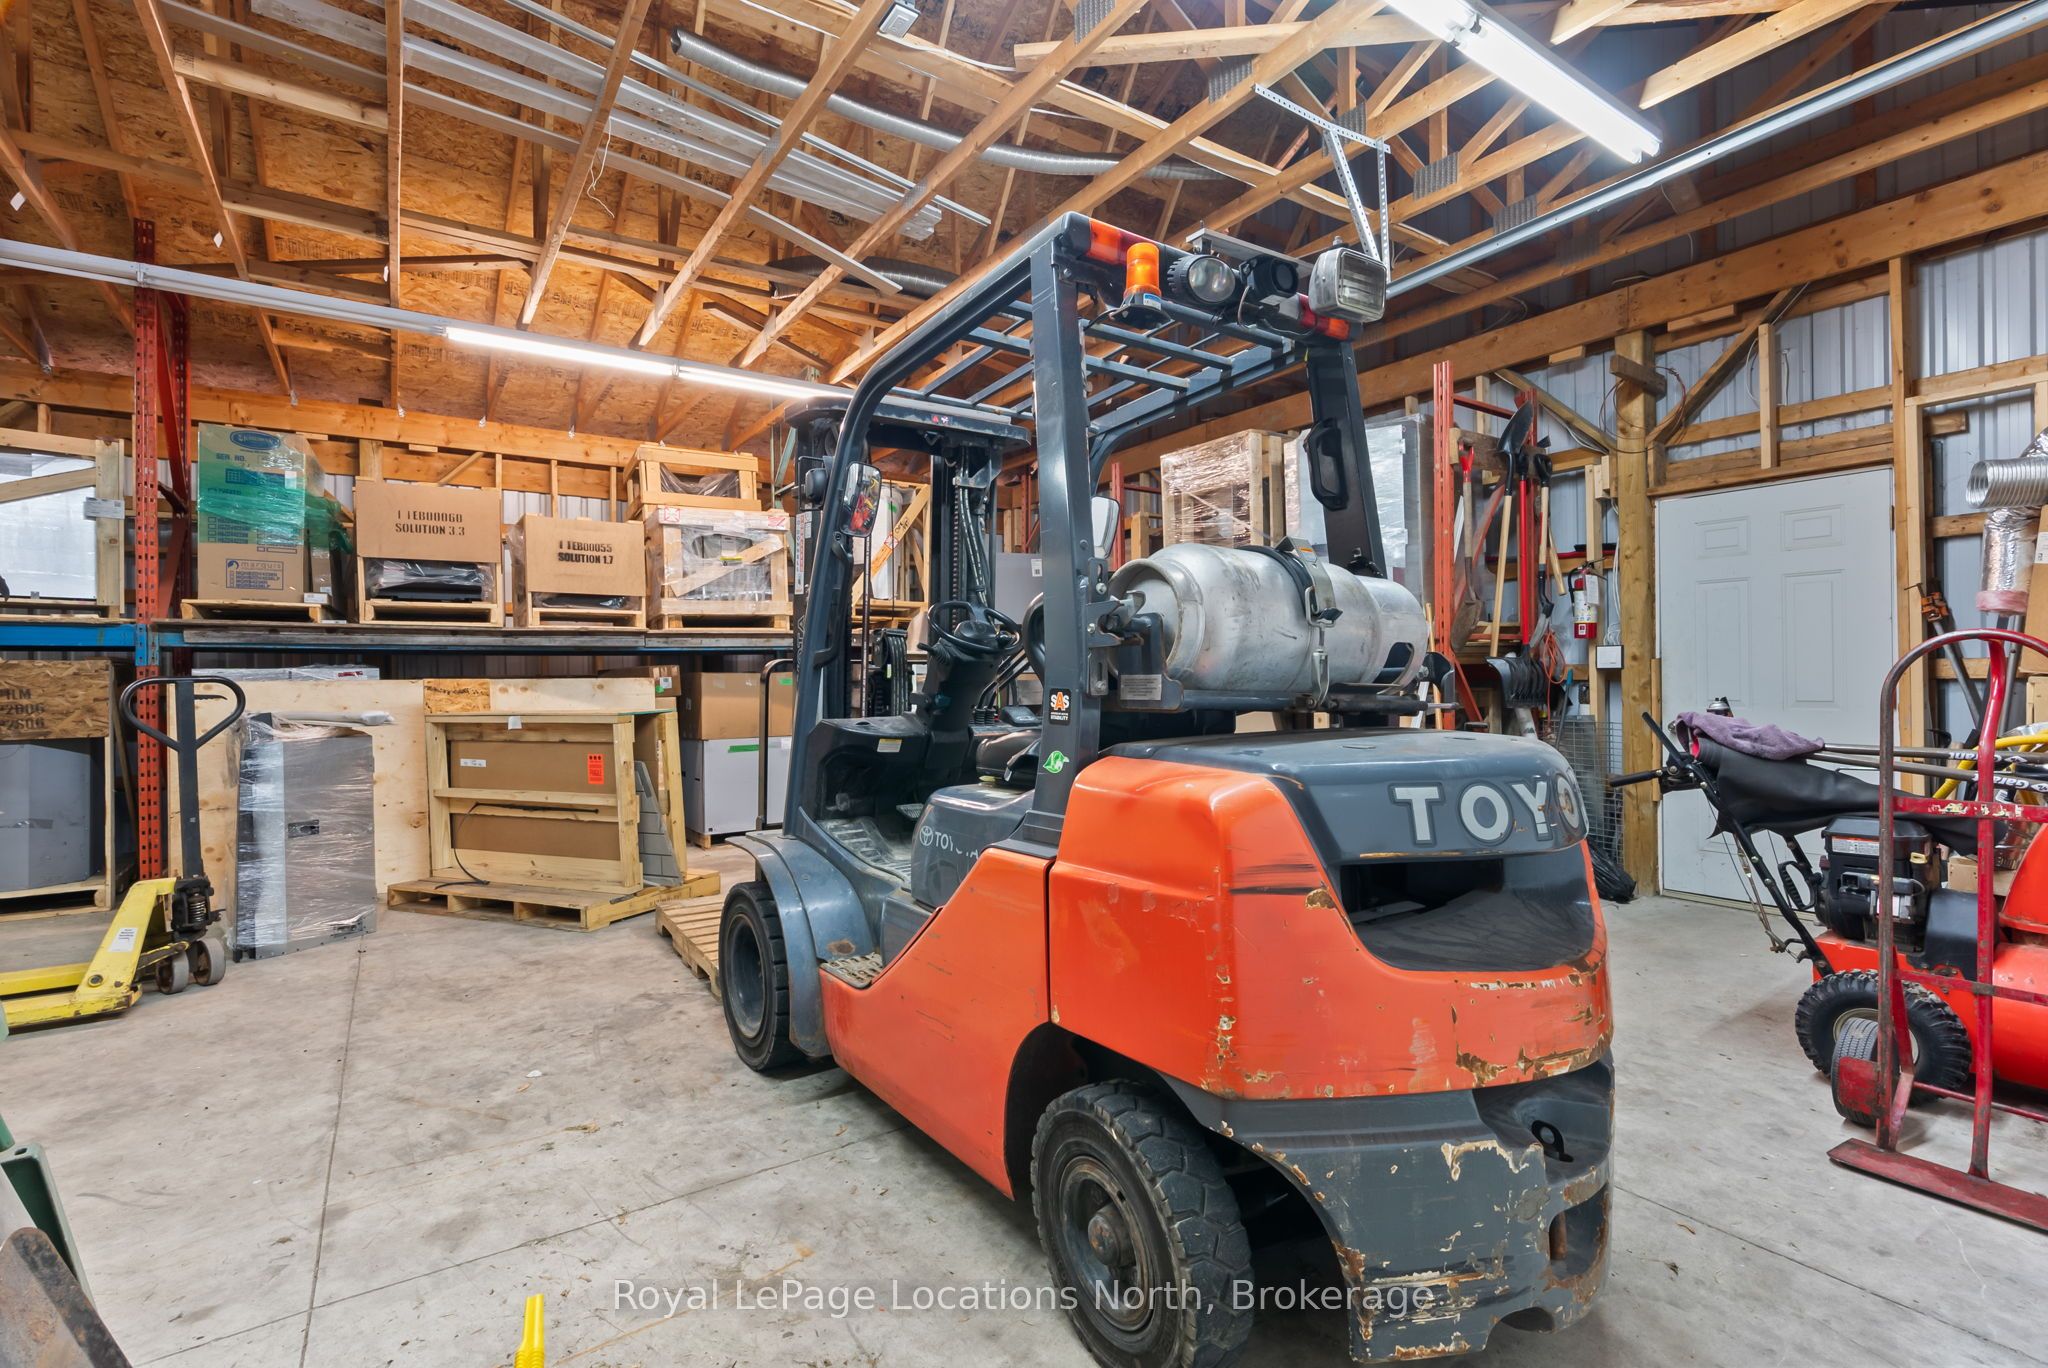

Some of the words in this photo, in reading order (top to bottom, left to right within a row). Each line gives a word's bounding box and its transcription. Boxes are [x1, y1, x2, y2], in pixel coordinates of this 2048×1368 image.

[395, 522, 446, 535] SOLUTION
[557, 551, 601, 565] SOLUTION
[1050, 691, 1070, 711] SAS
[1394, 772, 1588, 841] TOYO
